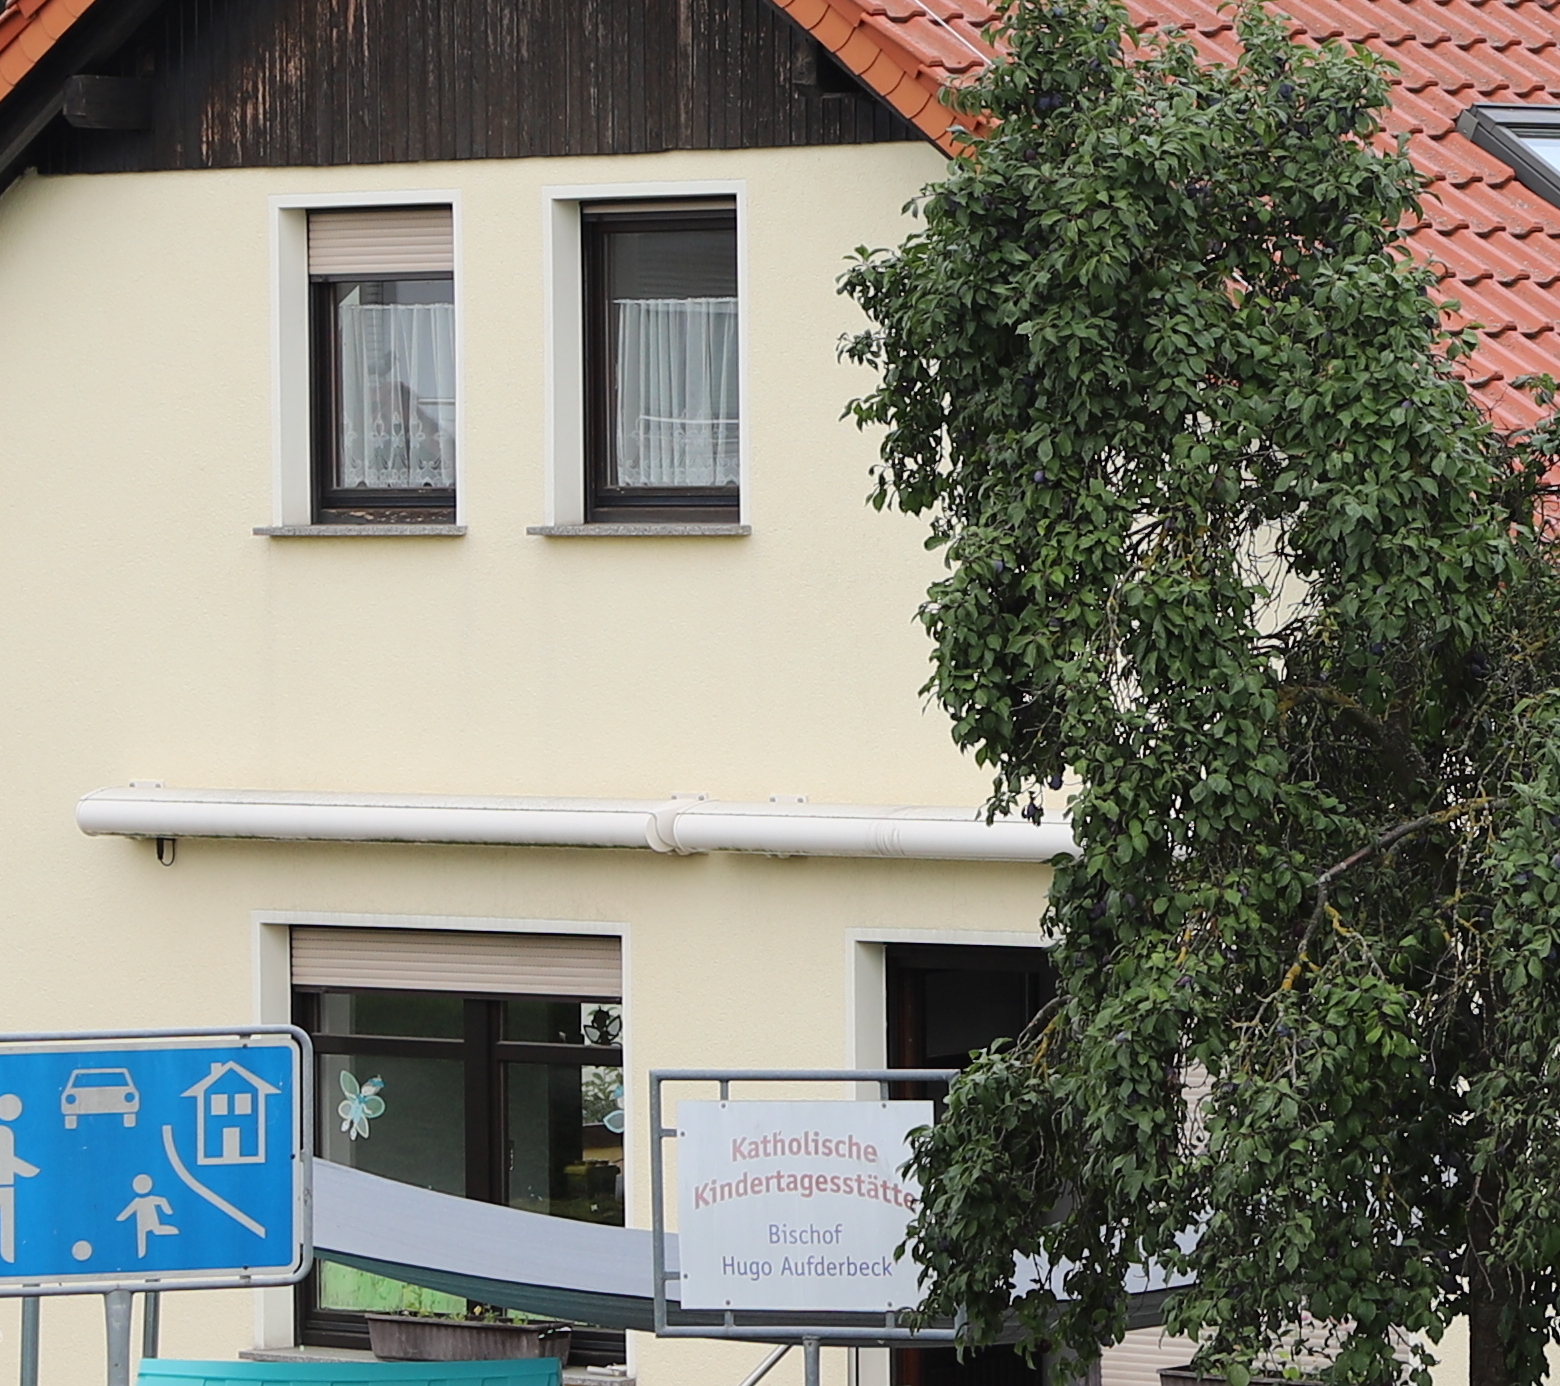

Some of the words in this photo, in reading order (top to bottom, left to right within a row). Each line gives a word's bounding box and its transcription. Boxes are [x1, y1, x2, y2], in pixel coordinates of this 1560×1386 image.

[731, 1130, 878, 1163] Katholische
[694, 1170, 917, 1211] Kindertagesstätte
[768, 1223, 843, 1245] Bischof
[721, 1255, 772, 1281] Hugo
[780, 1255, 893, 1277] Aufderbeck
